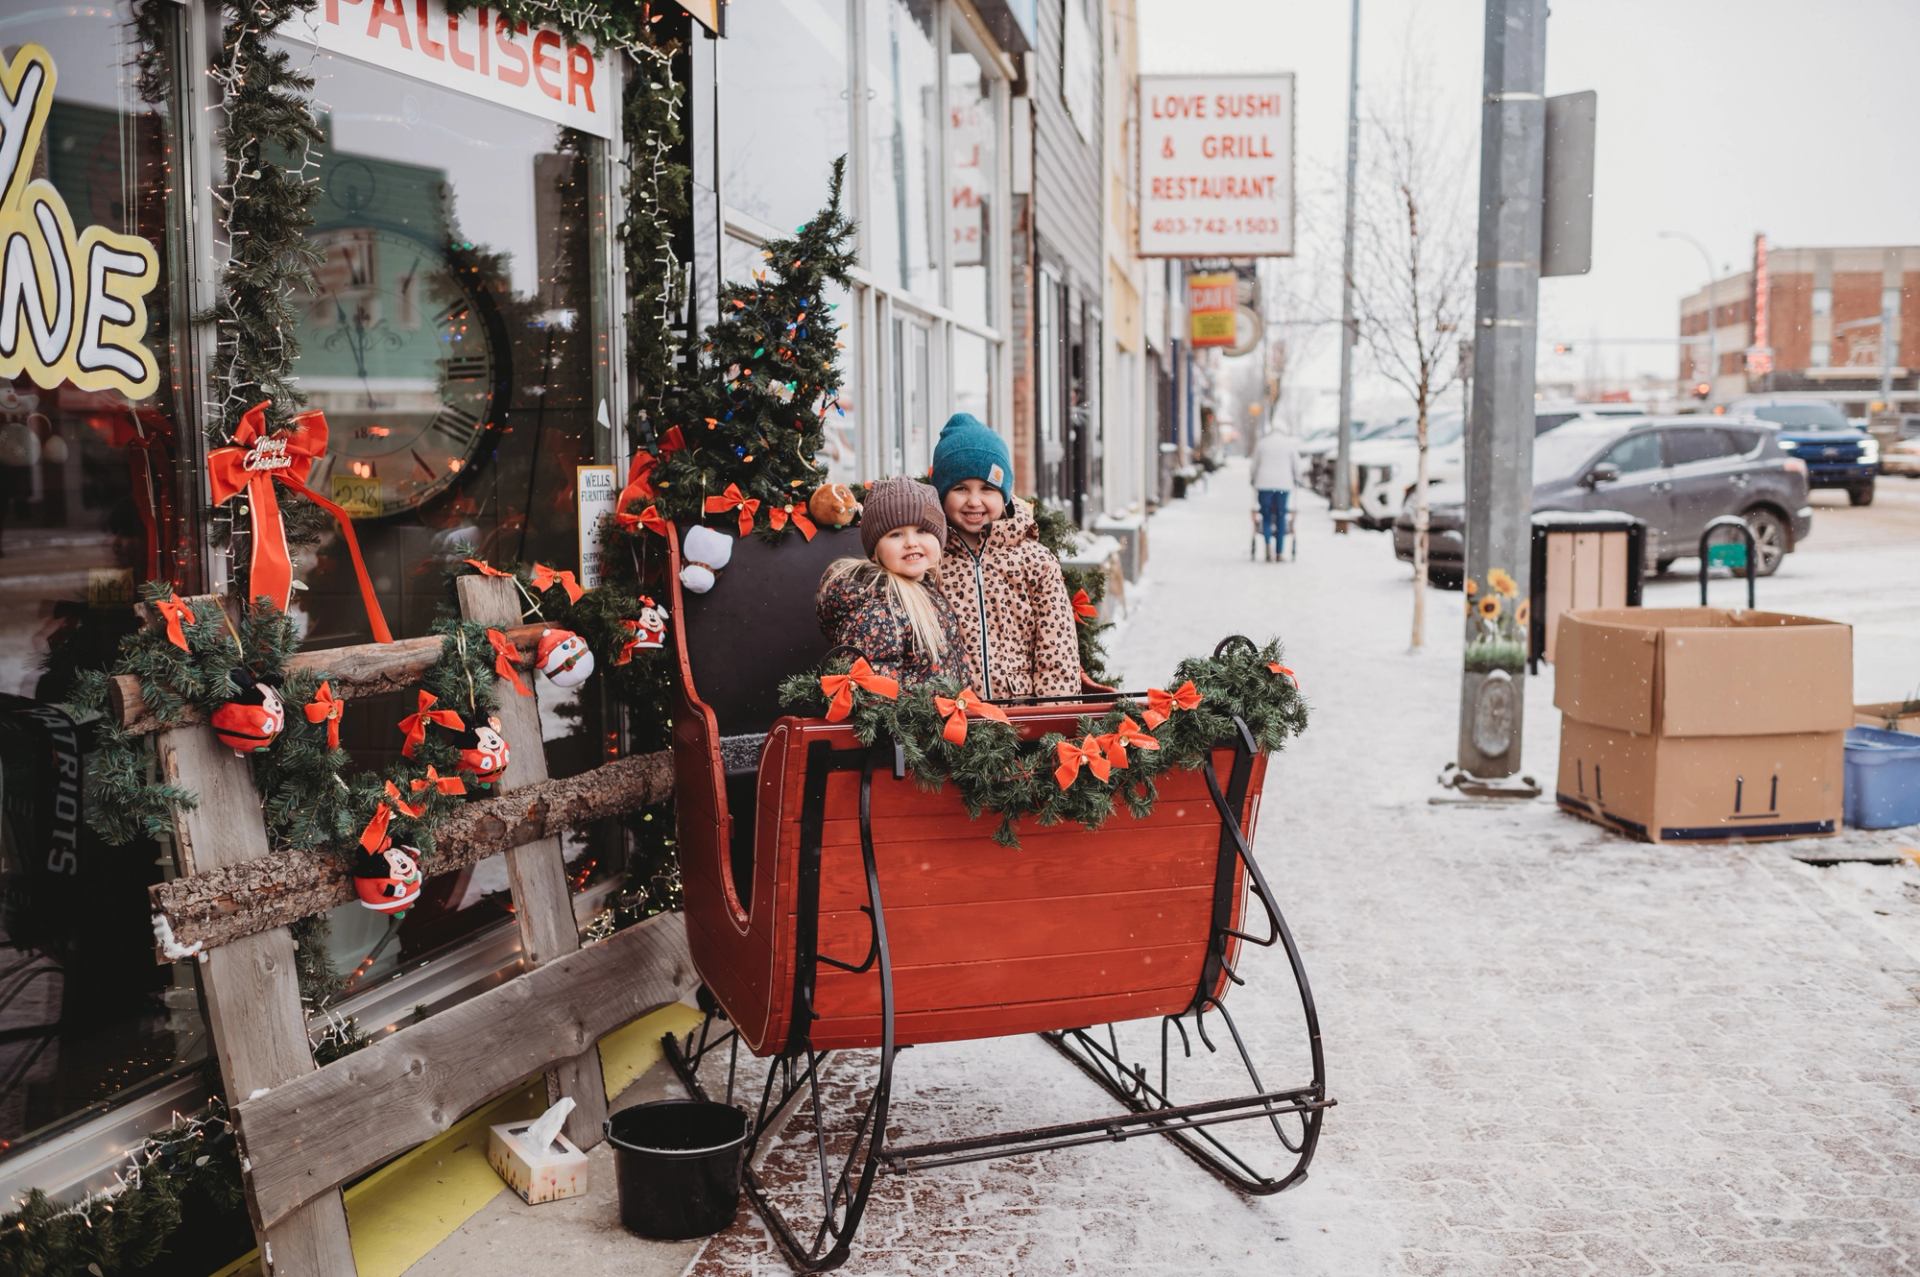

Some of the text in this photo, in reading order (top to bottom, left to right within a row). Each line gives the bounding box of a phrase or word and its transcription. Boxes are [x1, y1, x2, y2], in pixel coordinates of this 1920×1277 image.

[1152, 93, 1281, 119] LOVE SUSHI
[1161, 134, 1275, 159] & GRILL
[1152, 175, 1276, 200] RESTAURANT
[1152, 216, 1280, 235] 403-742-1503
[584, 474, 611, 488] WELLS
[581, 489, 615, 502] FURNITURE
